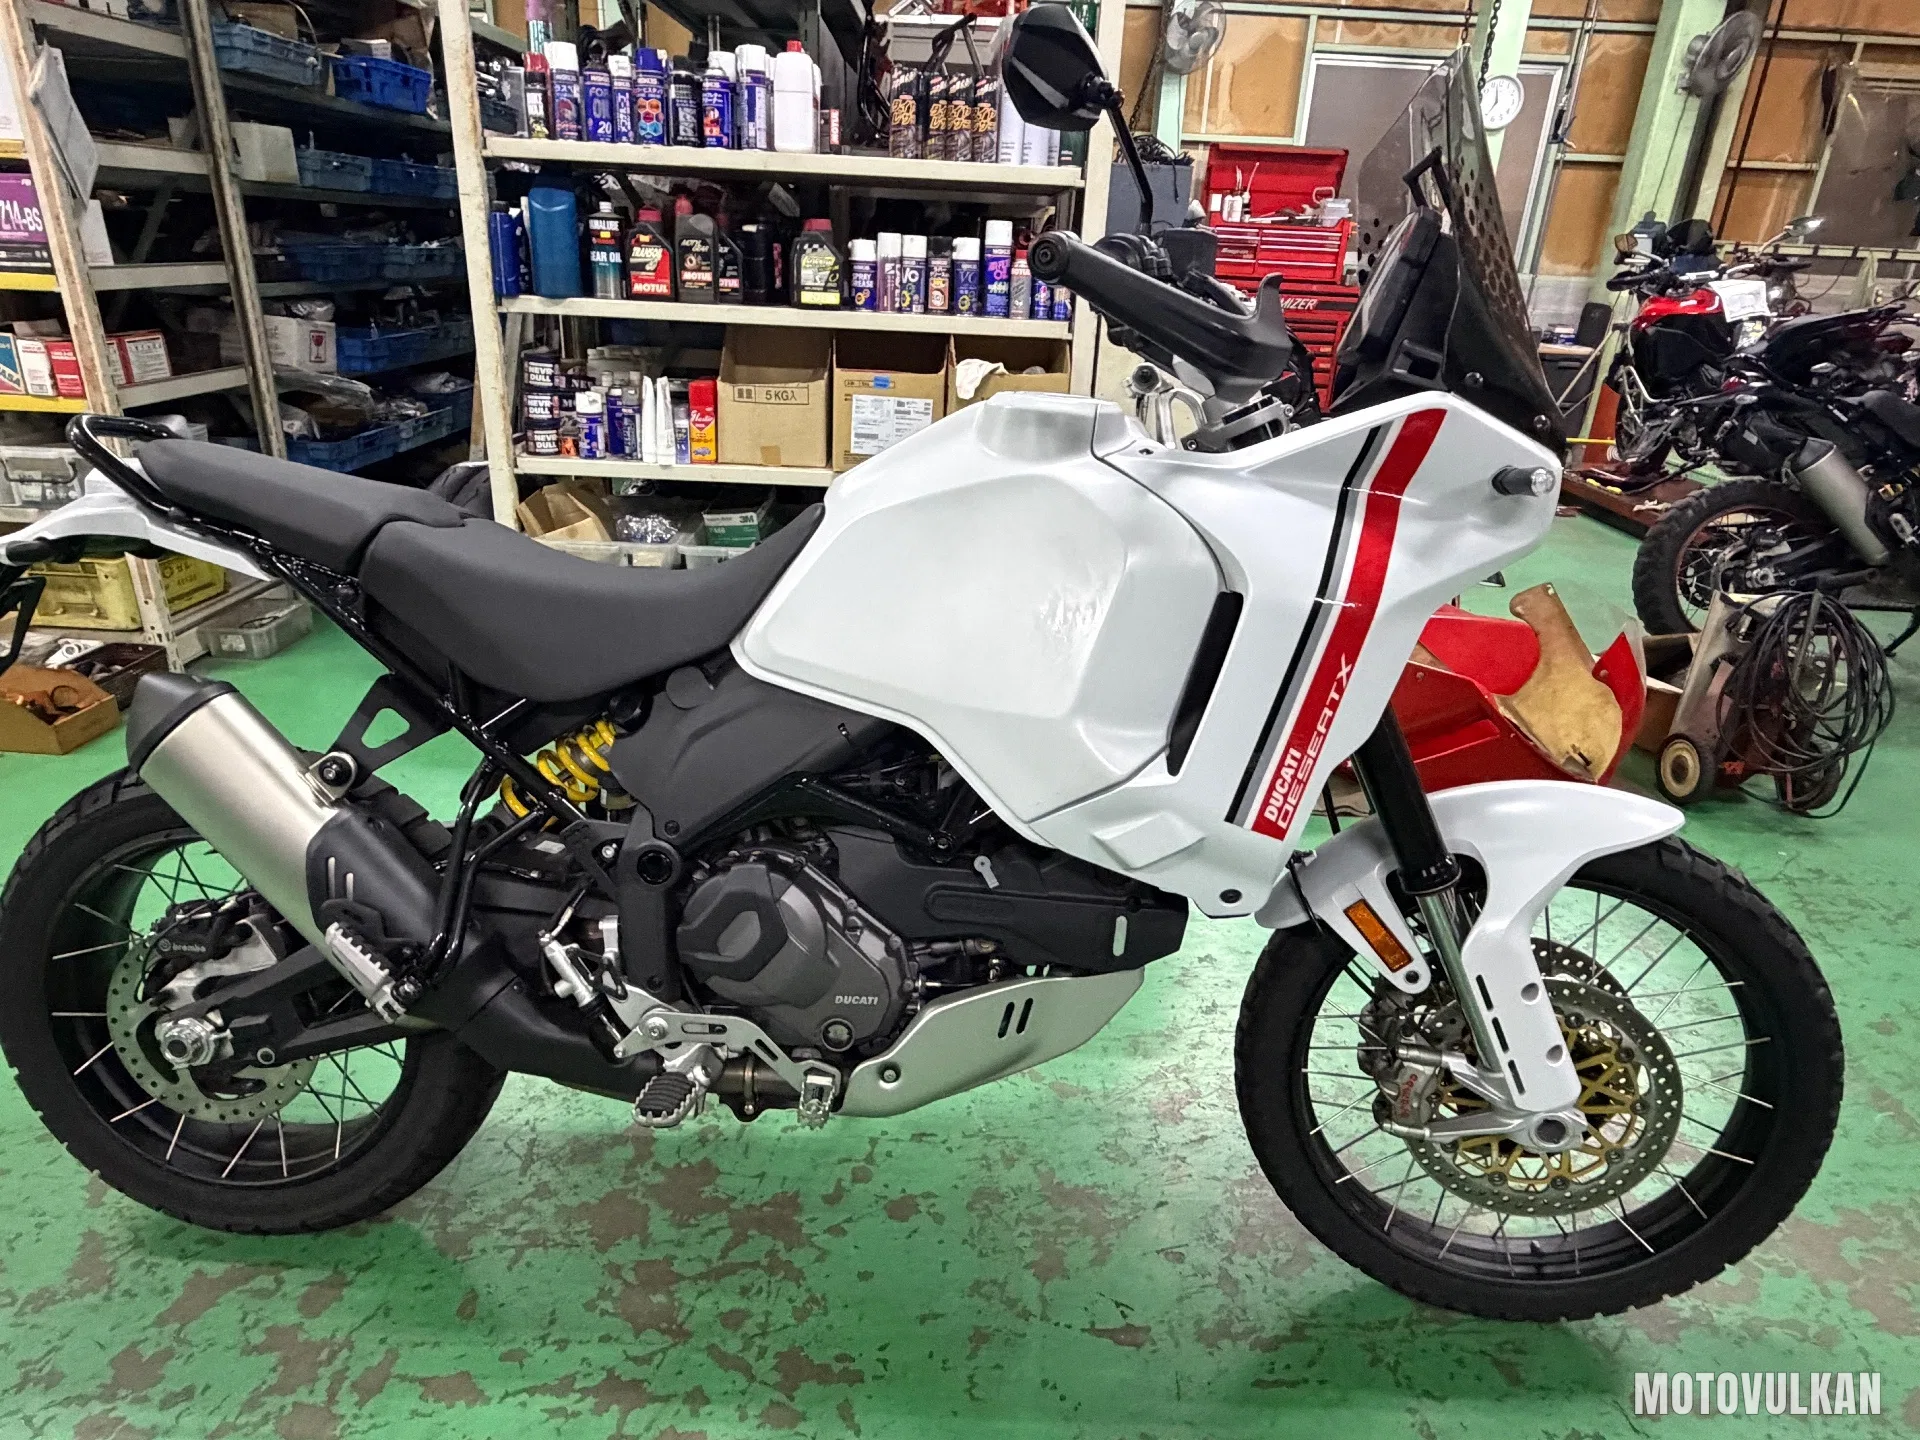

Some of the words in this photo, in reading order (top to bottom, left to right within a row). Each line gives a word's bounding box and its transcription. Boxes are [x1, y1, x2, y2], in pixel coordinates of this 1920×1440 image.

[597, 121, 612, 134] 20
[609, 252, 622, 262] OIL
[633, 283, 668, 293] MOTUL
[530, 373, 552, 382] DULL
[528, 406, 550, 415] DULL
[535, 440, 557, 449] DULL
[739, 515, 755, 523] 3M
[1264, 747, 1302, 822] DUCATI
[834, 995, 879, 1005] DUCATI
